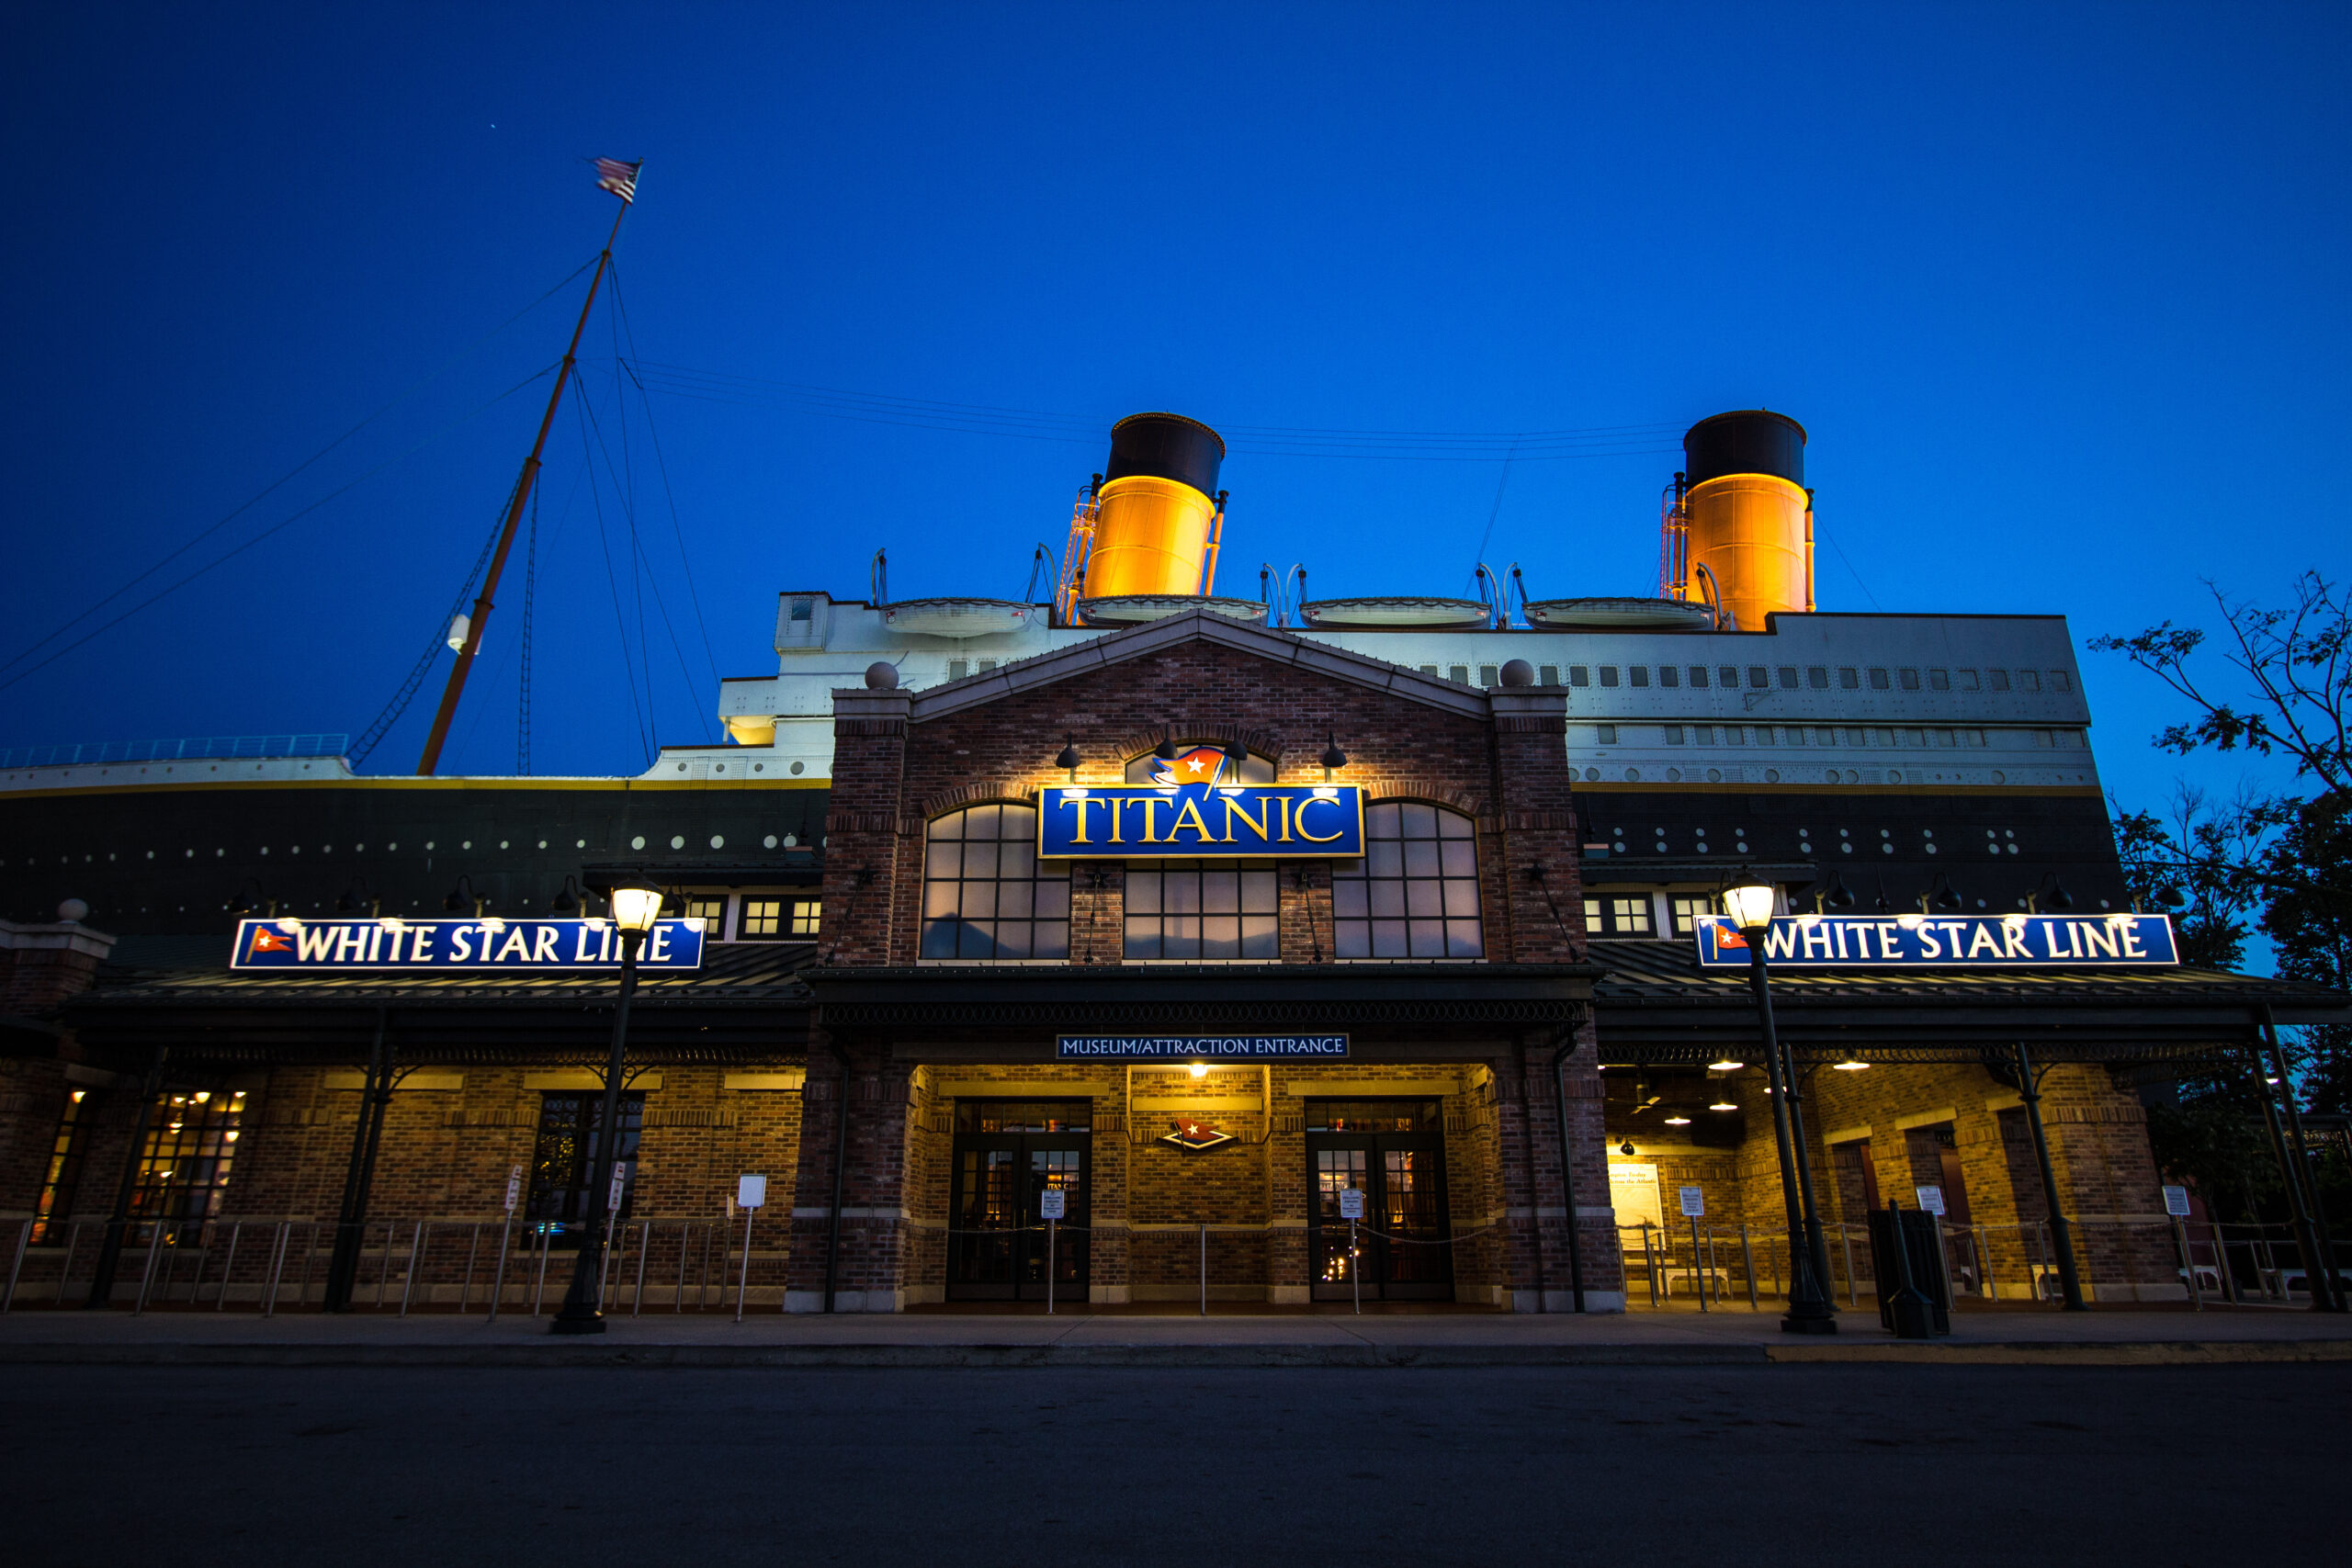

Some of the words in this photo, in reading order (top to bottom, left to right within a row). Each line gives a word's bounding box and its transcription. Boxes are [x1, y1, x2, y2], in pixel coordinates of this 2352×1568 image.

[1058, 795, 1344, 844] TITANIC
[296, 925, 436, 963] WHITE
[448, 925, 560, 963] STAR
[1763, 921, 1905, 959] WHITE
[1915, 921, 2034, 959] STAR
[2043, 921, 2148, 958] LINE
[1062, 1038, 1250, 1055] MUSEUM/ATTRACTION
[1255, 1037, 1343, 1054] ENTRANCE
